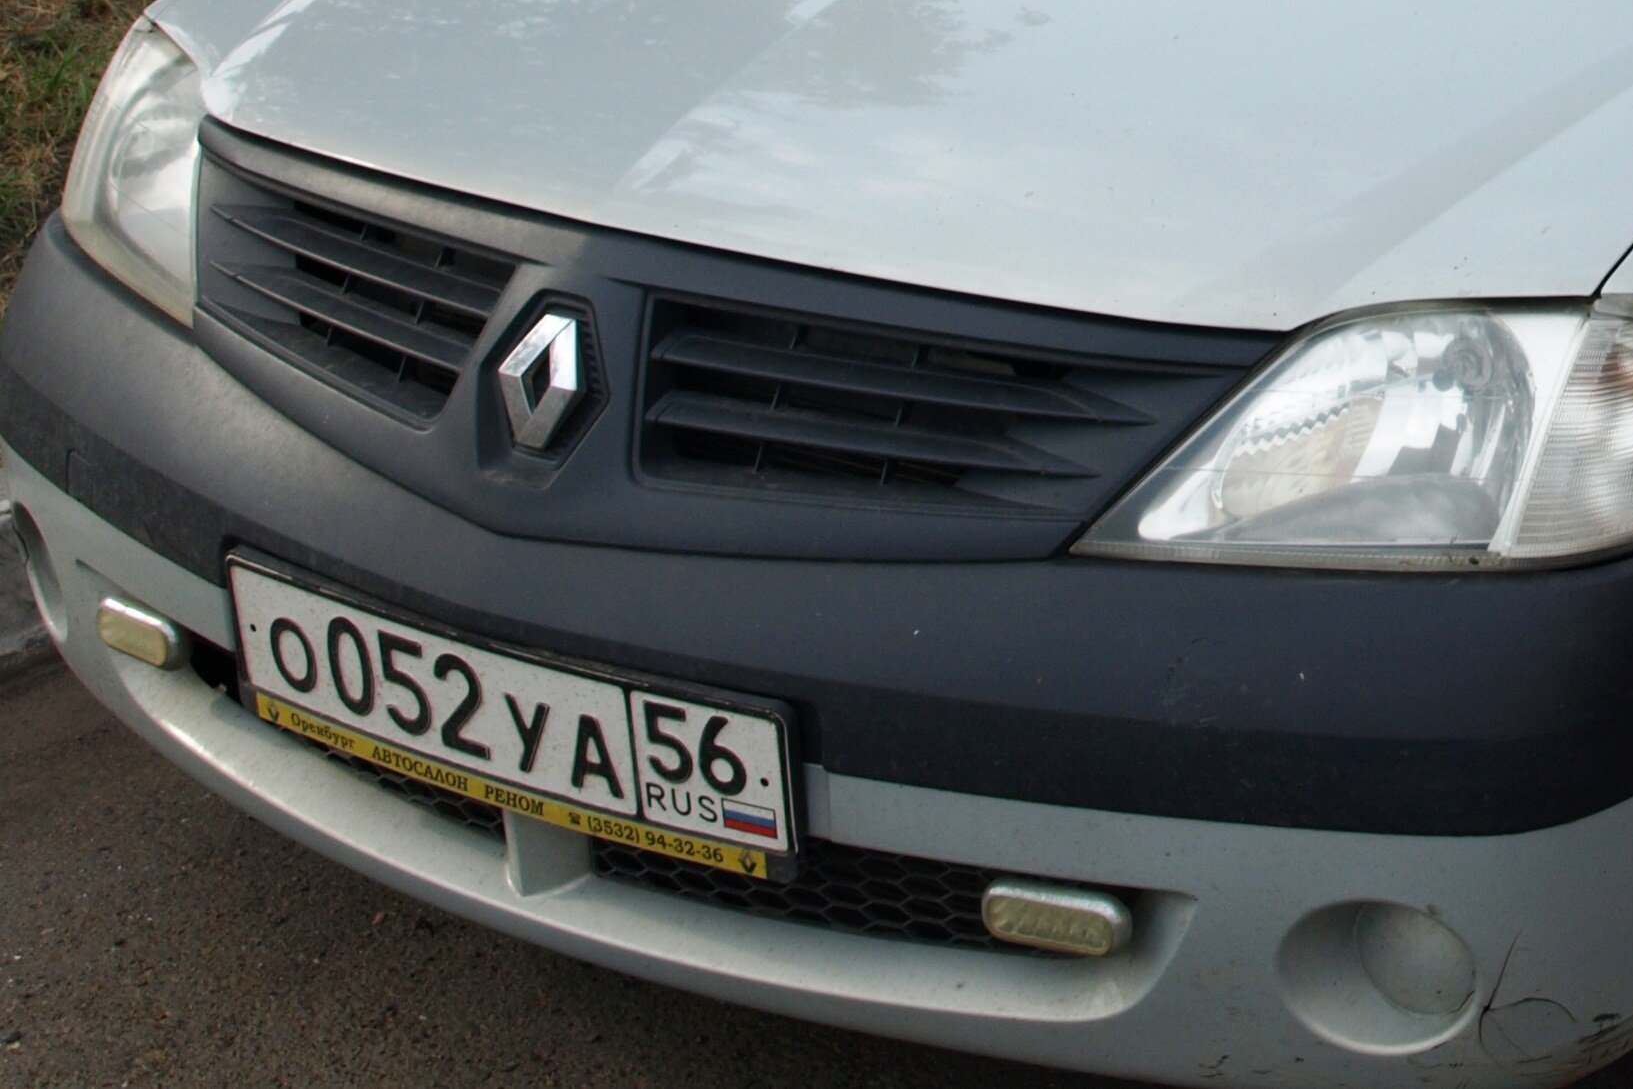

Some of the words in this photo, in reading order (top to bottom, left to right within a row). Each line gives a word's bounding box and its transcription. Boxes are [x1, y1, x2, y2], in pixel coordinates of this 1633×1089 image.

[291, 712, 355, 748] Оренбург
[372, 745, 469, 791] АВТОСАЛОН
[587, 816, 640, 843] (3532)
[645, 830, 724, 862] 94-32-36
[643, 699, 747, 796] 56
[645, 782, 718, 822] RUS
